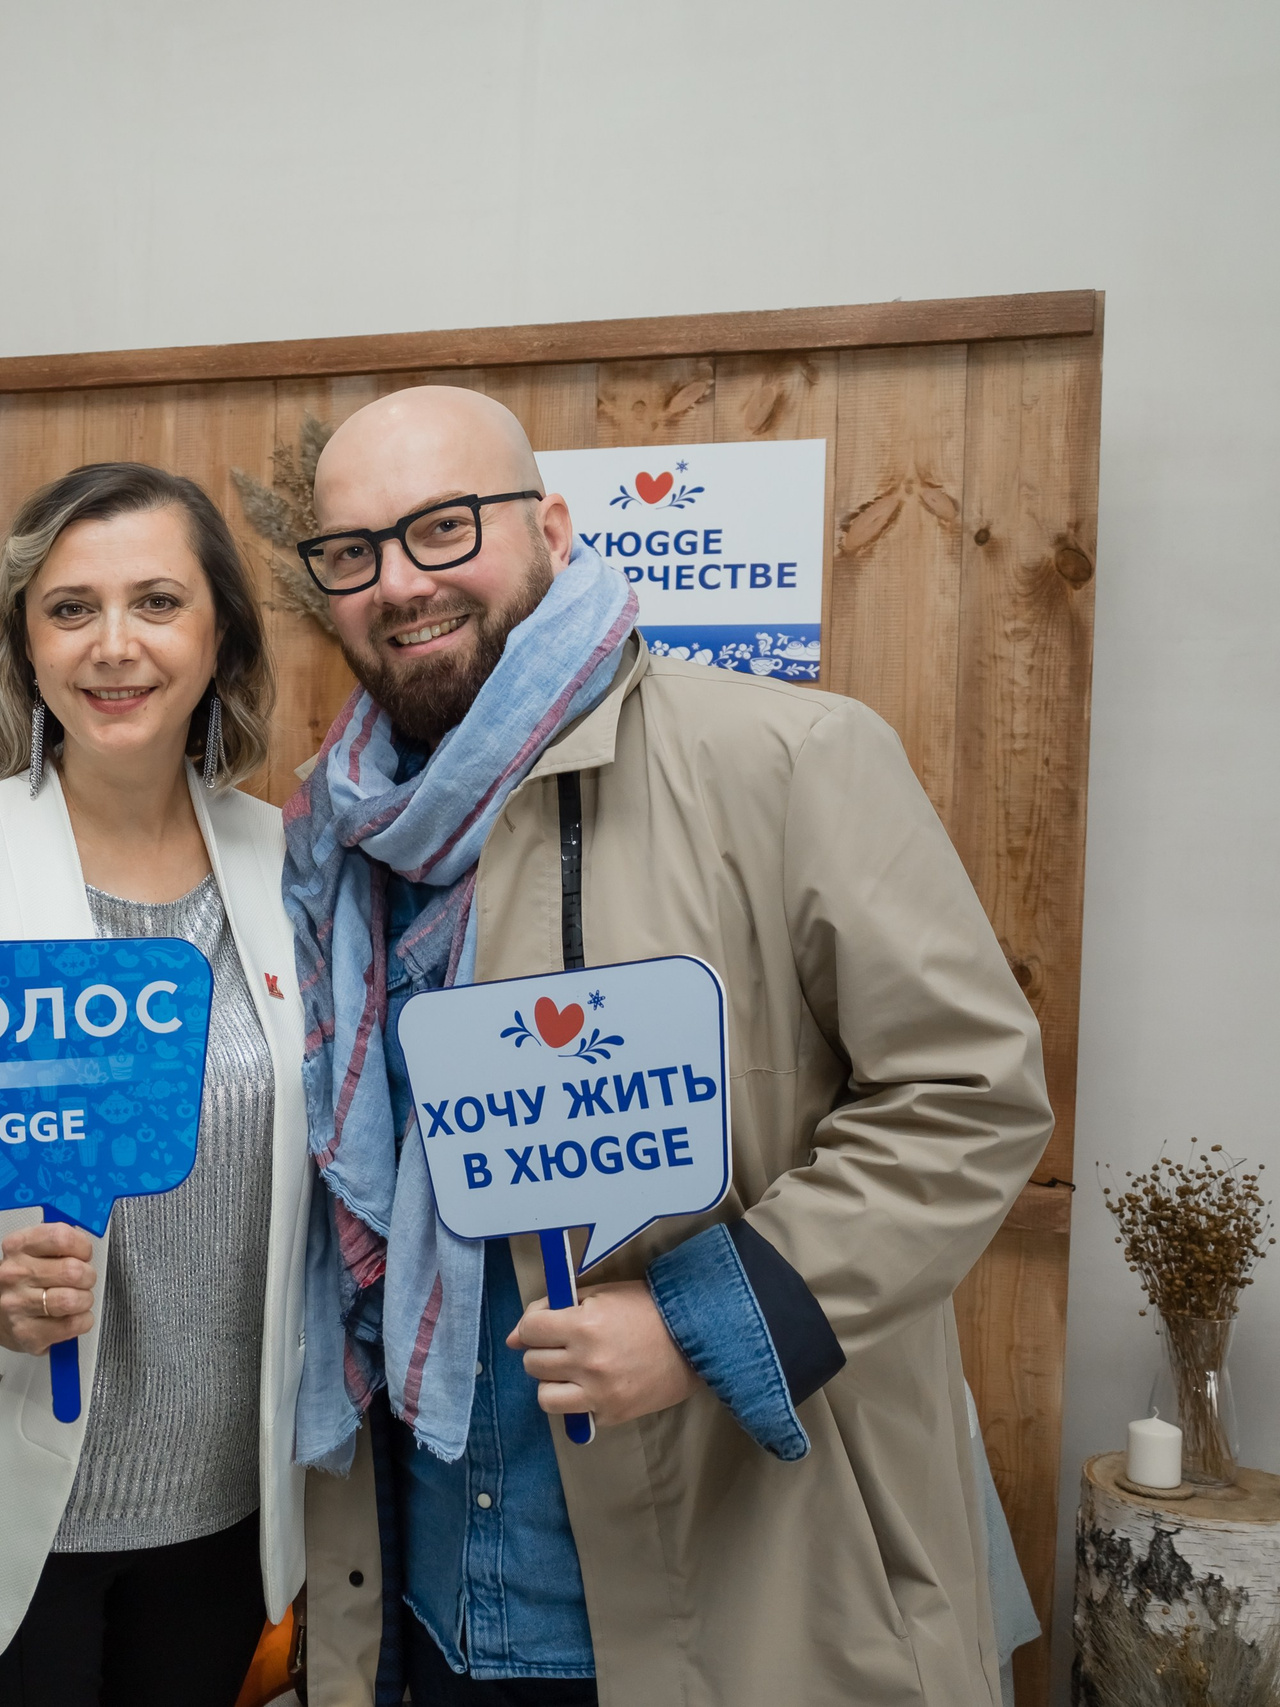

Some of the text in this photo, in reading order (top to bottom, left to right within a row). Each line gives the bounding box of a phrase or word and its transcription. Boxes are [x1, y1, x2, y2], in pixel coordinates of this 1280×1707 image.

[422, 1064, 718, 1139] ХОЧУ ЖИТЬ
[463, 1126, 694, 1190] В ХЮGGE
